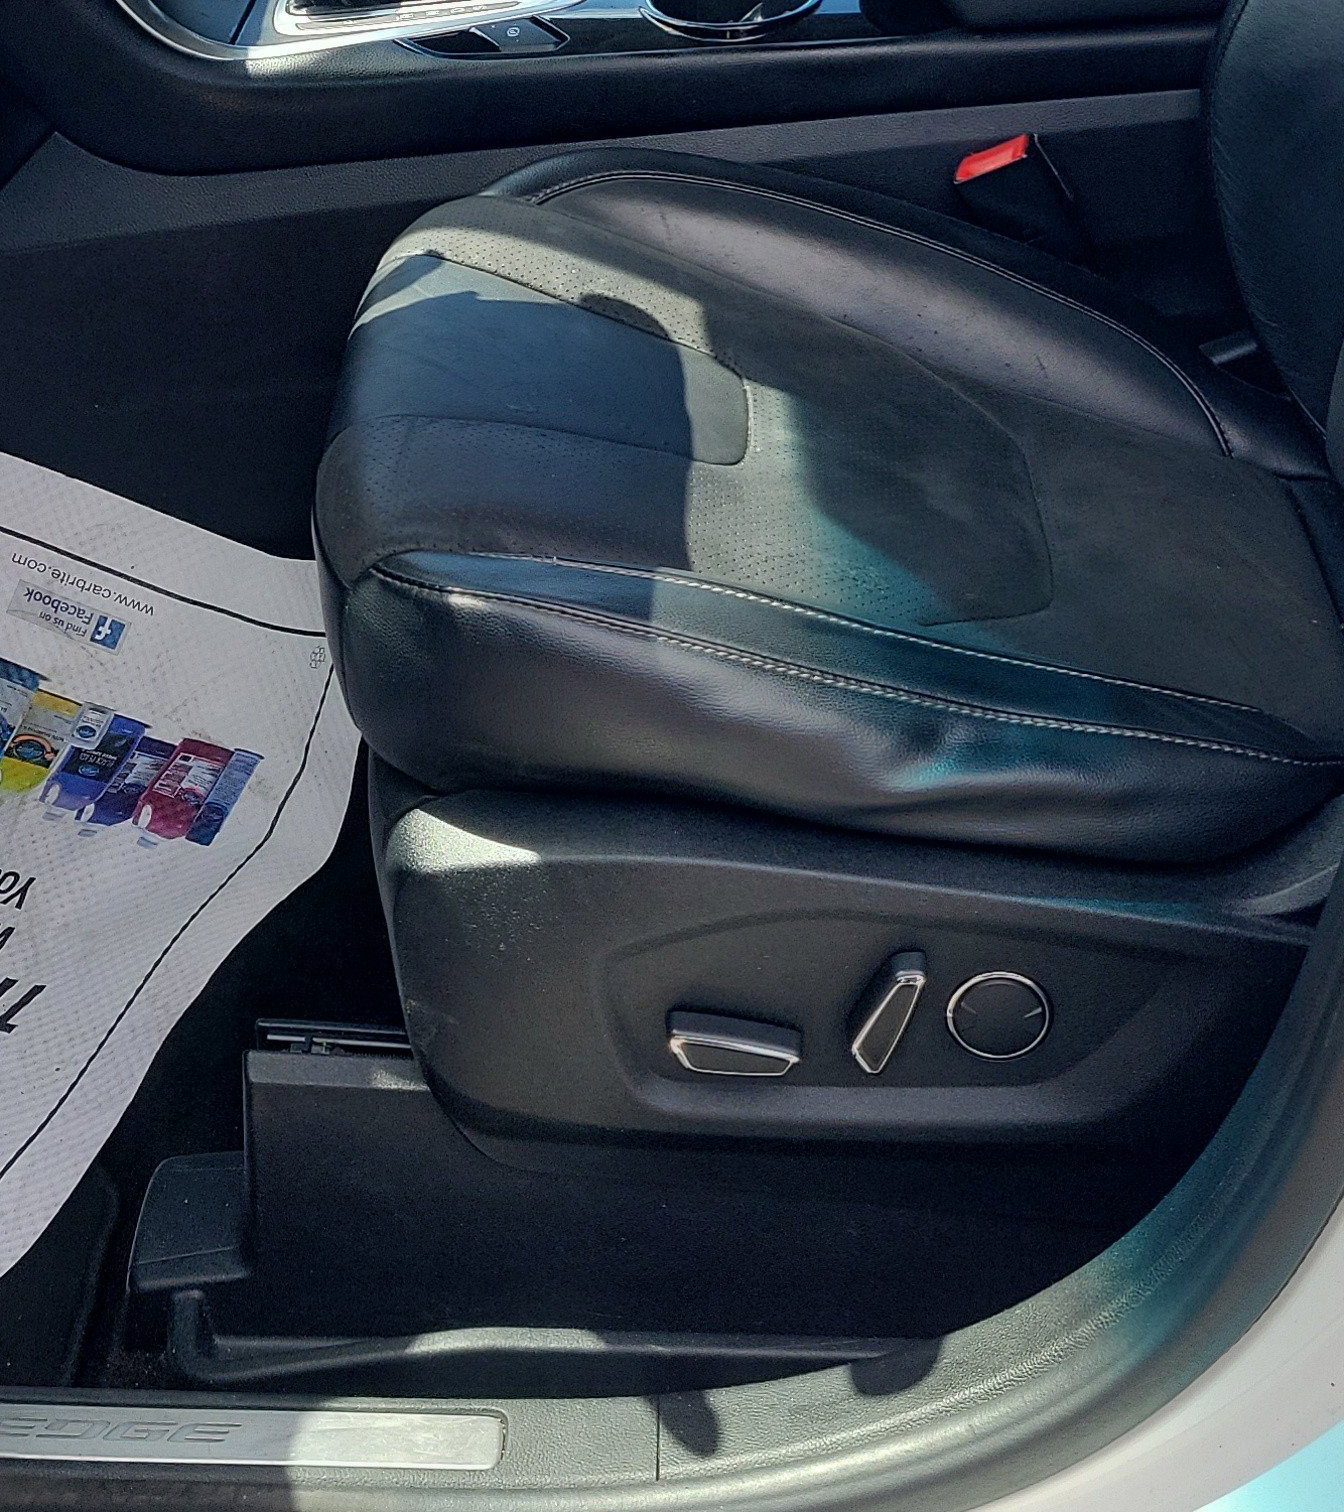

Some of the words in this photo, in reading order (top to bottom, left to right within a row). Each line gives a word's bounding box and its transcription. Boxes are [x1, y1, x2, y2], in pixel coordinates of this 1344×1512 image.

[11, 552, 154, 616] www.carbrite.com
[23, 587, 94, 625] Facebook
[38, 610, 51, 621] on
[54, 616, 65, 627] us
[66, 622, 88, 637] Find
